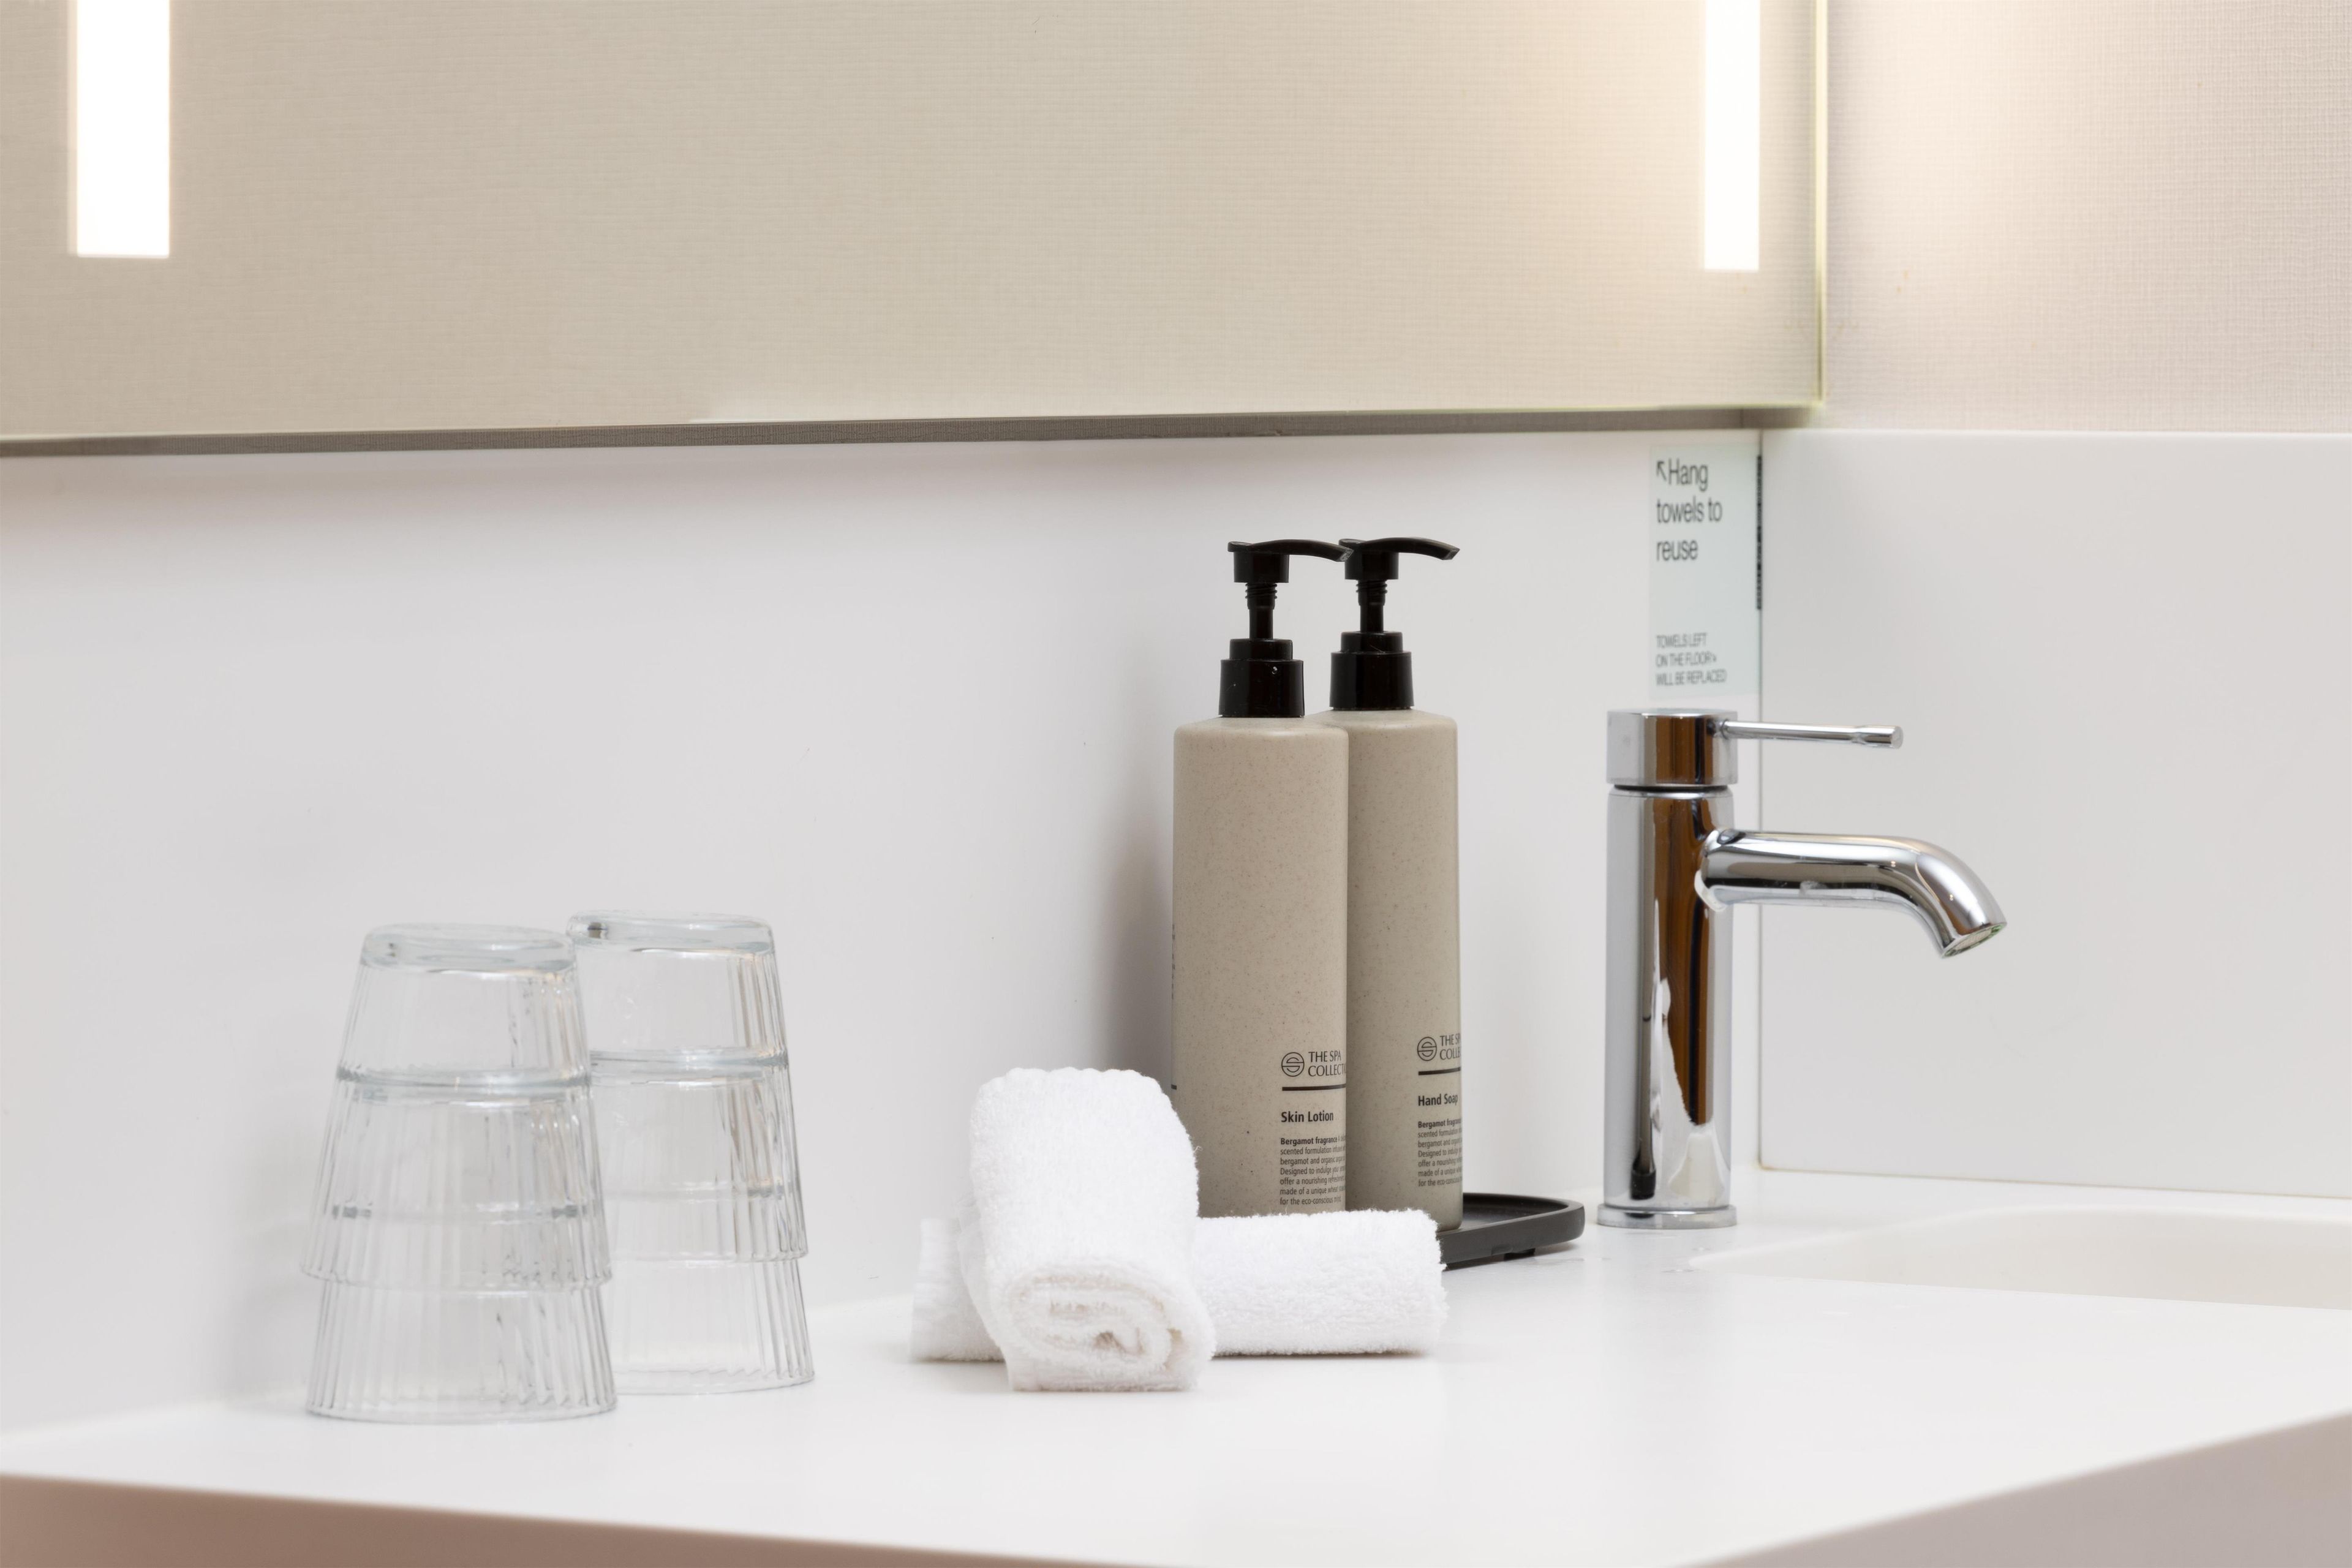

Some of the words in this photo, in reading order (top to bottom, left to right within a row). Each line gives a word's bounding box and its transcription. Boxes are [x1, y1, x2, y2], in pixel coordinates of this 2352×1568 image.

[1668, 458, 1708, 492] Hang
[1656, 495, 1704, 523] towels
[1708, 497, 1722, 522] to
[1656, 540, 1698, 561] reuse
[1656, 633, 1687, 648] TOWELS
[1689, 632, 1706, 647] LEFT
[1656, 653, 1668, 668] ON
[1670, 652, 1683, 666] THE
[1656, 671, 1673, 686] WILL
[1675, 671, 1684, 685] BE
[1686, 668, 1727, 684] REPLACED
[1439, 1034, 1454, 1047] THE
[1308, 1051, 1328, 1063] THE
[1329, 1050, 1341, 1062] SPA
[1417, 1093, 1442, 1106] Hand
[1444, 1093, 1458, 1106] Soap
[1281, 1110, 1305, 1122] Skin
[1308, 1110, 1333, 1122] Lotion
[1418, 1121, 1446, 1129] Bergamot
[1418, 1129, 1438, 1138] scented
[1280, 1138, 1314, 1147] Bergamot
[1316, 1136, 1337, 1145] fragrance
[1418, 1140, 1442, 1149] bergamot
[1305, 1145, 1332, 1154] formulation
[1419, 1150, 1441, 1159] Designed
[1280, 1158, 1309, 1166] bergamot
[1321, 1156, 1335, 1165] organic
[1280, 1167, 1307, 1176] Designed
[1316, 1166, 1332, 1175] indulge
[1419, 1169, 1433, 1177] made
[1302, 1177, 1327, 1185] nourishing
[1311, 1187, 1327, 1196] unique
[1291, 1197, 1300, 1205] the
